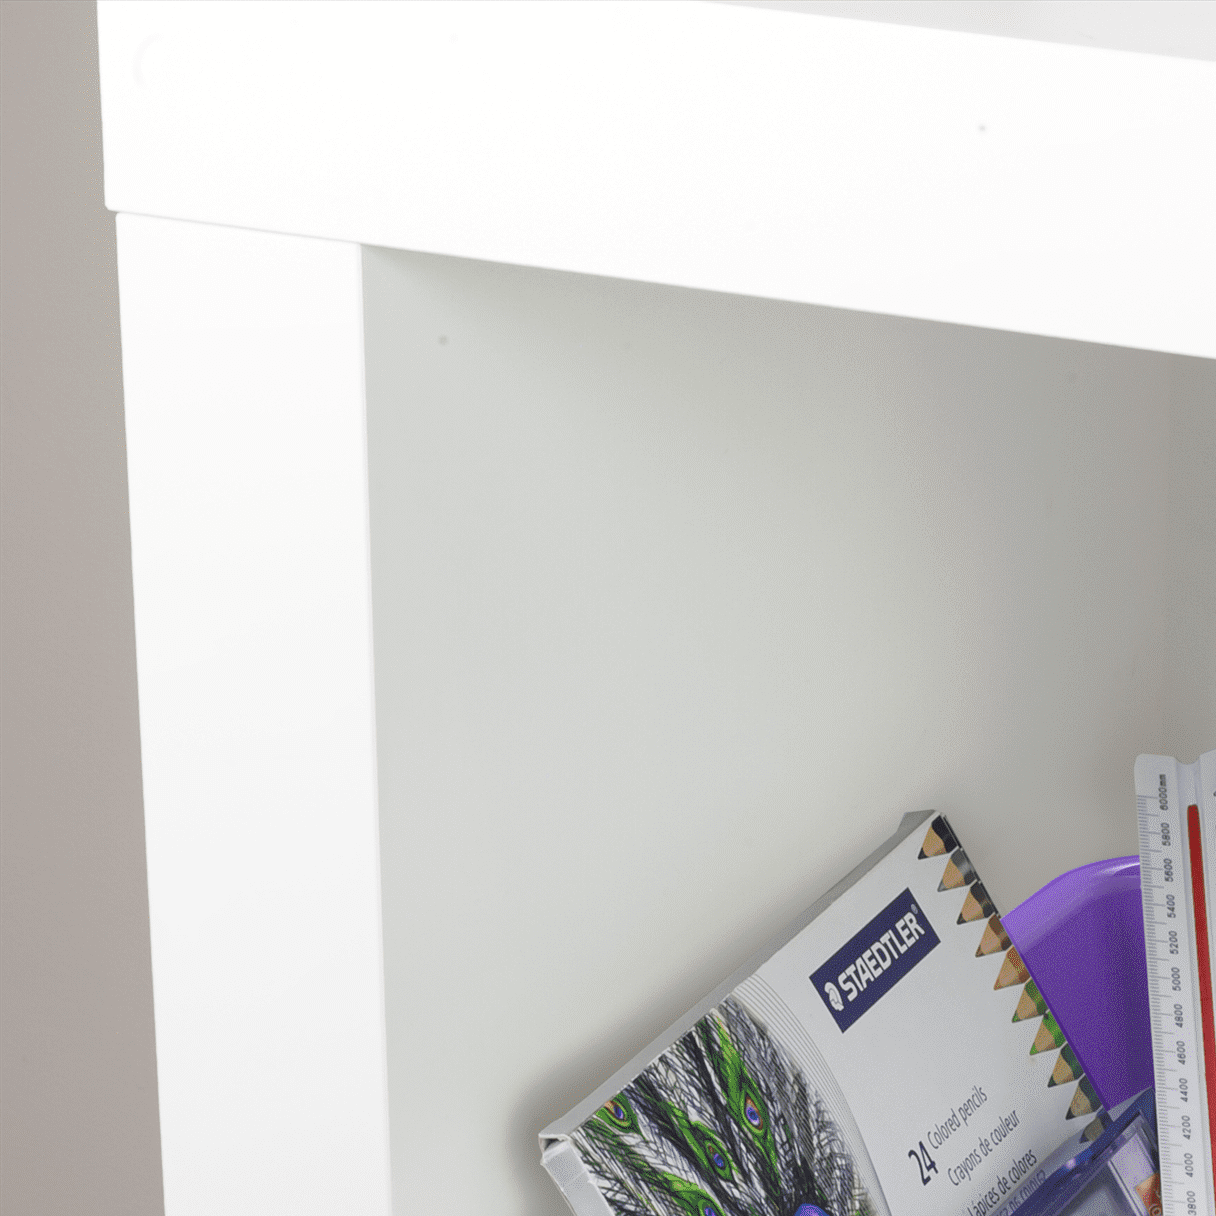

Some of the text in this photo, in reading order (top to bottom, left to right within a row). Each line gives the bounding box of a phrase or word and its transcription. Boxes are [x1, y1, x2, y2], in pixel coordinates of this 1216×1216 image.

[1158, 773, 1169, 811] 6000mm
[1161, 822, 1171, 847] 5800
[1163, 858, 1174, 883] 5600
[1166, 894, 1177, 919] 5400
[1169, 930, 1179, 955] 5200
[837, 911, 926, 1002] STAEDTLER
[1171, 966, 1181, 992] 5000
[1174, 1003, 1184, 1029] 4800
[1176, 1040, 1187, 1066] 4600
[1178, 1077, 1189, 1103] 4400
[908, 1085, 988, 1186] 24 Colored pencils
[1181, 1115, 1191, 1141] 4200
[948, 1109, 1021, 1187] Crayons de couleur
[997, 1175, 1012, 1196] de
[1008, 1148, 1038, 1185] colores
[1184, 1152, 1194, 1178] 4000
[1187, 1190, 1197, 1216] 3800
